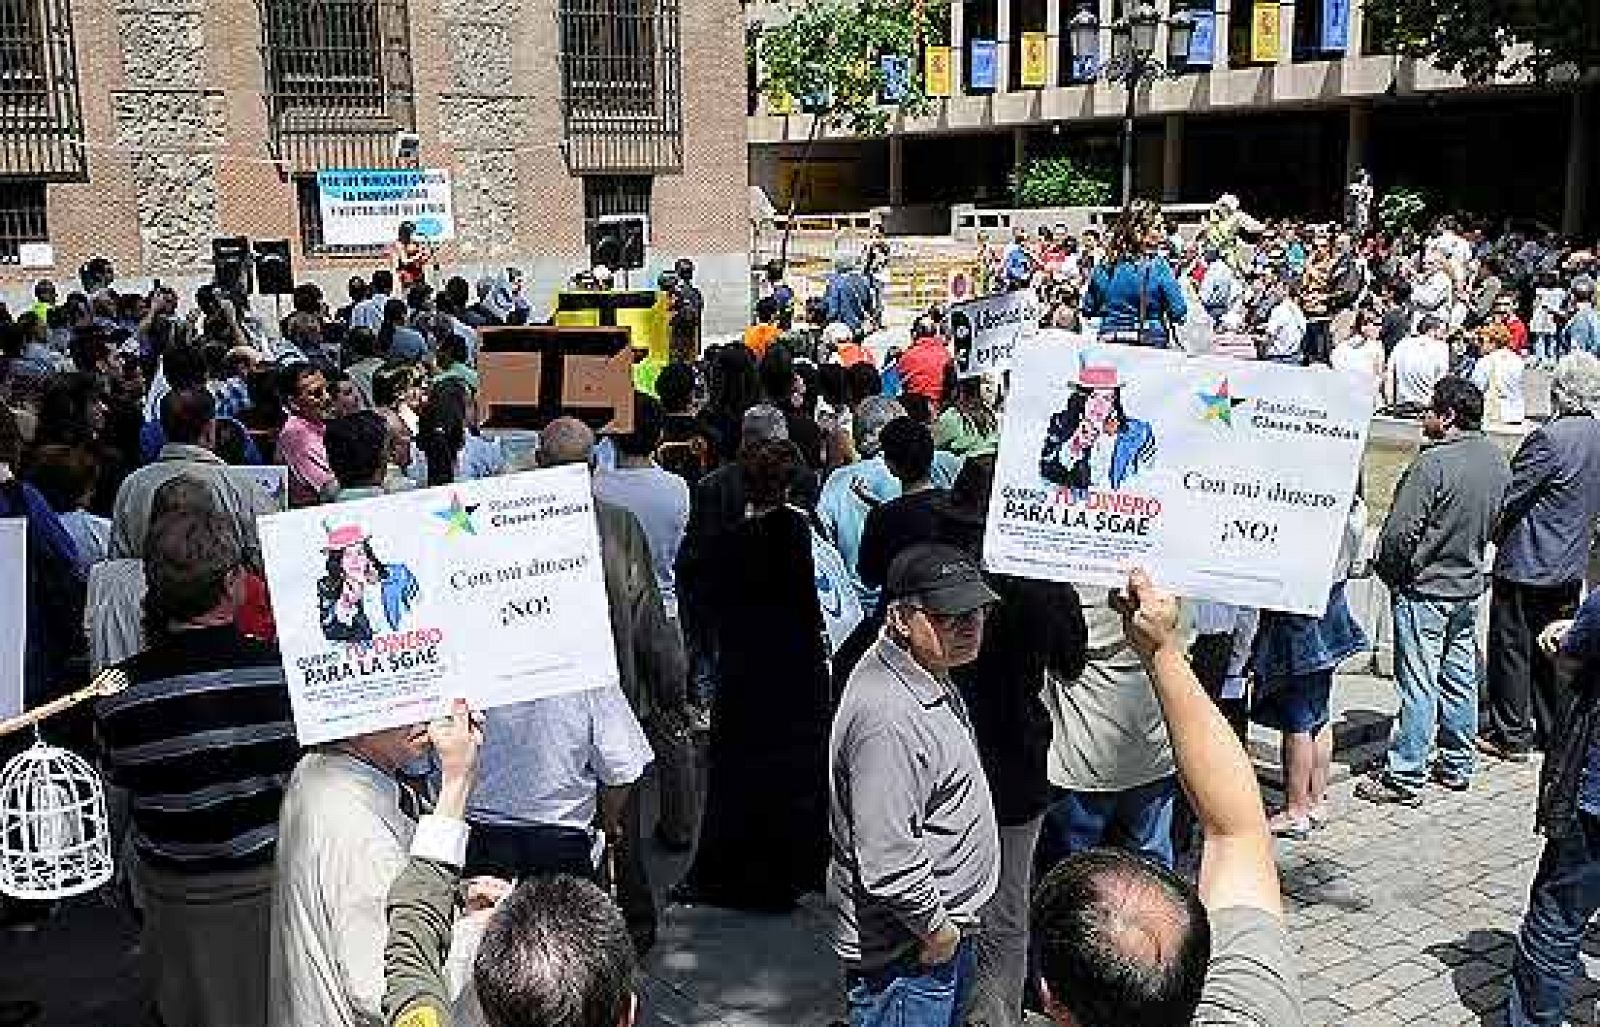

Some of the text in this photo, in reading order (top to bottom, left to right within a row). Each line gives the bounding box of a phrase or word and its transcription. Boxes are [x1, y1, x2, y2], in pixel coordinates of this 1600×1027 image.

[1303, 421, 1359, 440] Medias
[1087, 491, 1162, 518] DINERO
[1184, 471, 1336, 509] Con mi dinero
[1003, 500, 1057, 525] PARA
[1061, 509, 1089, 530] LA
[1221, 520, 1278, 543] ¡NO!
[450, 555, 588, 591] Con mi dinero
[501, 596, 551, 625] ¡NO!
[371, 628, 443, 655] DINERO
[304, 662, 356, 686] PARA
[358, 657, 385, 676] LA
